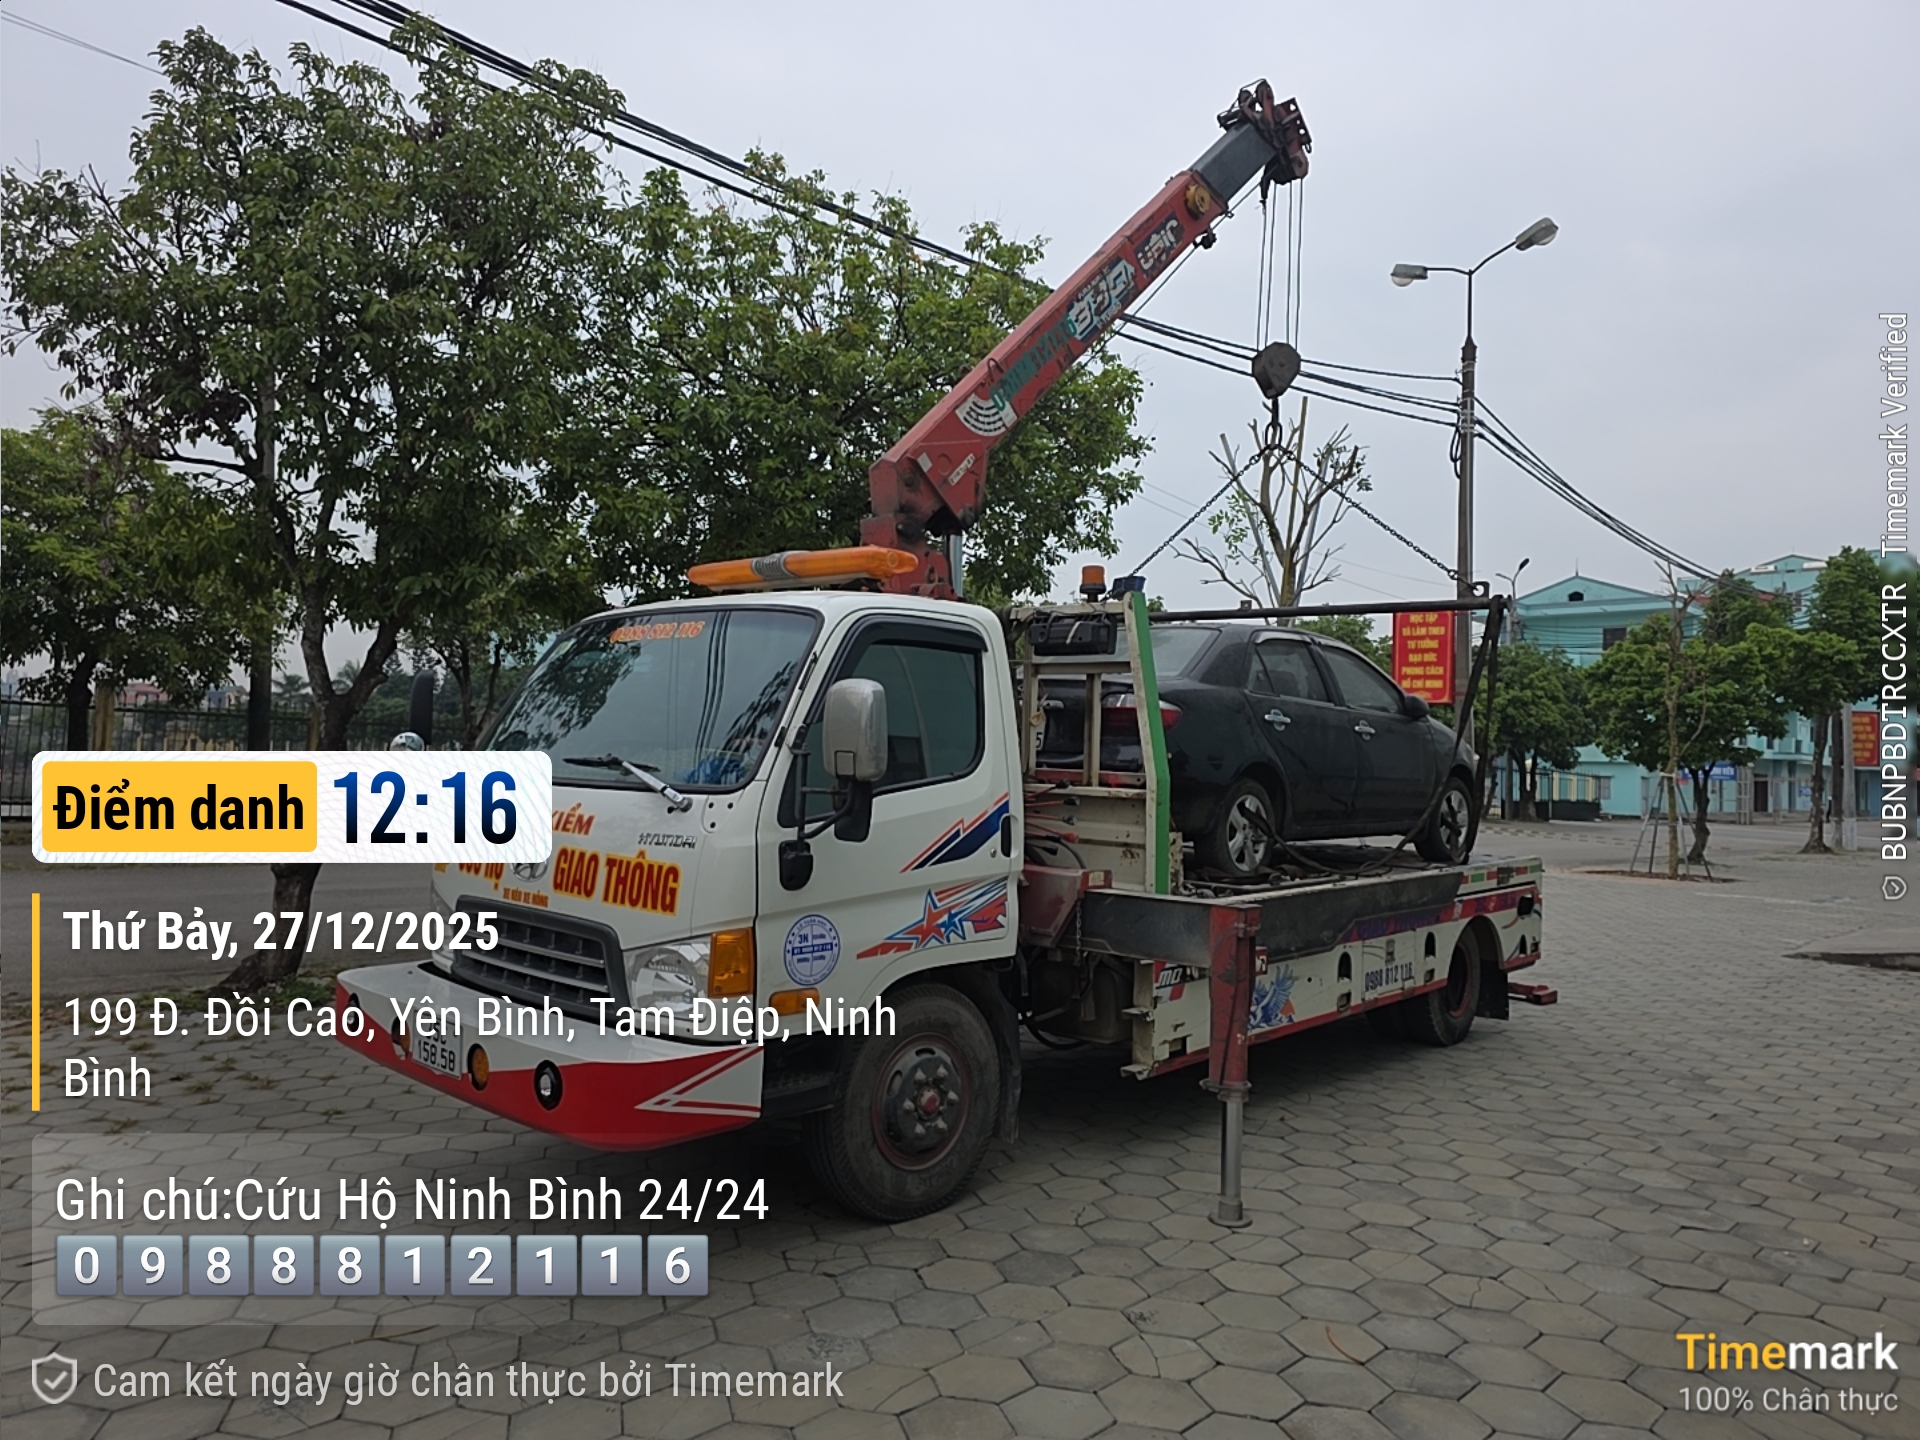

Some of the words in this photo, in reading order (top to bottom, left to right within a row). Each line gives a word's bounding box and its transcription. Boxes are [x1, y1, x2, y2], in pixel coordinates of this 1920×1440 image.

[637, 832, 698, 849] HYUNDAI
[553, 847, 600, 898] GIAO
[602, 850, 680, 914] THÔNG
[418, 1040, 455, 1072] 158.58
